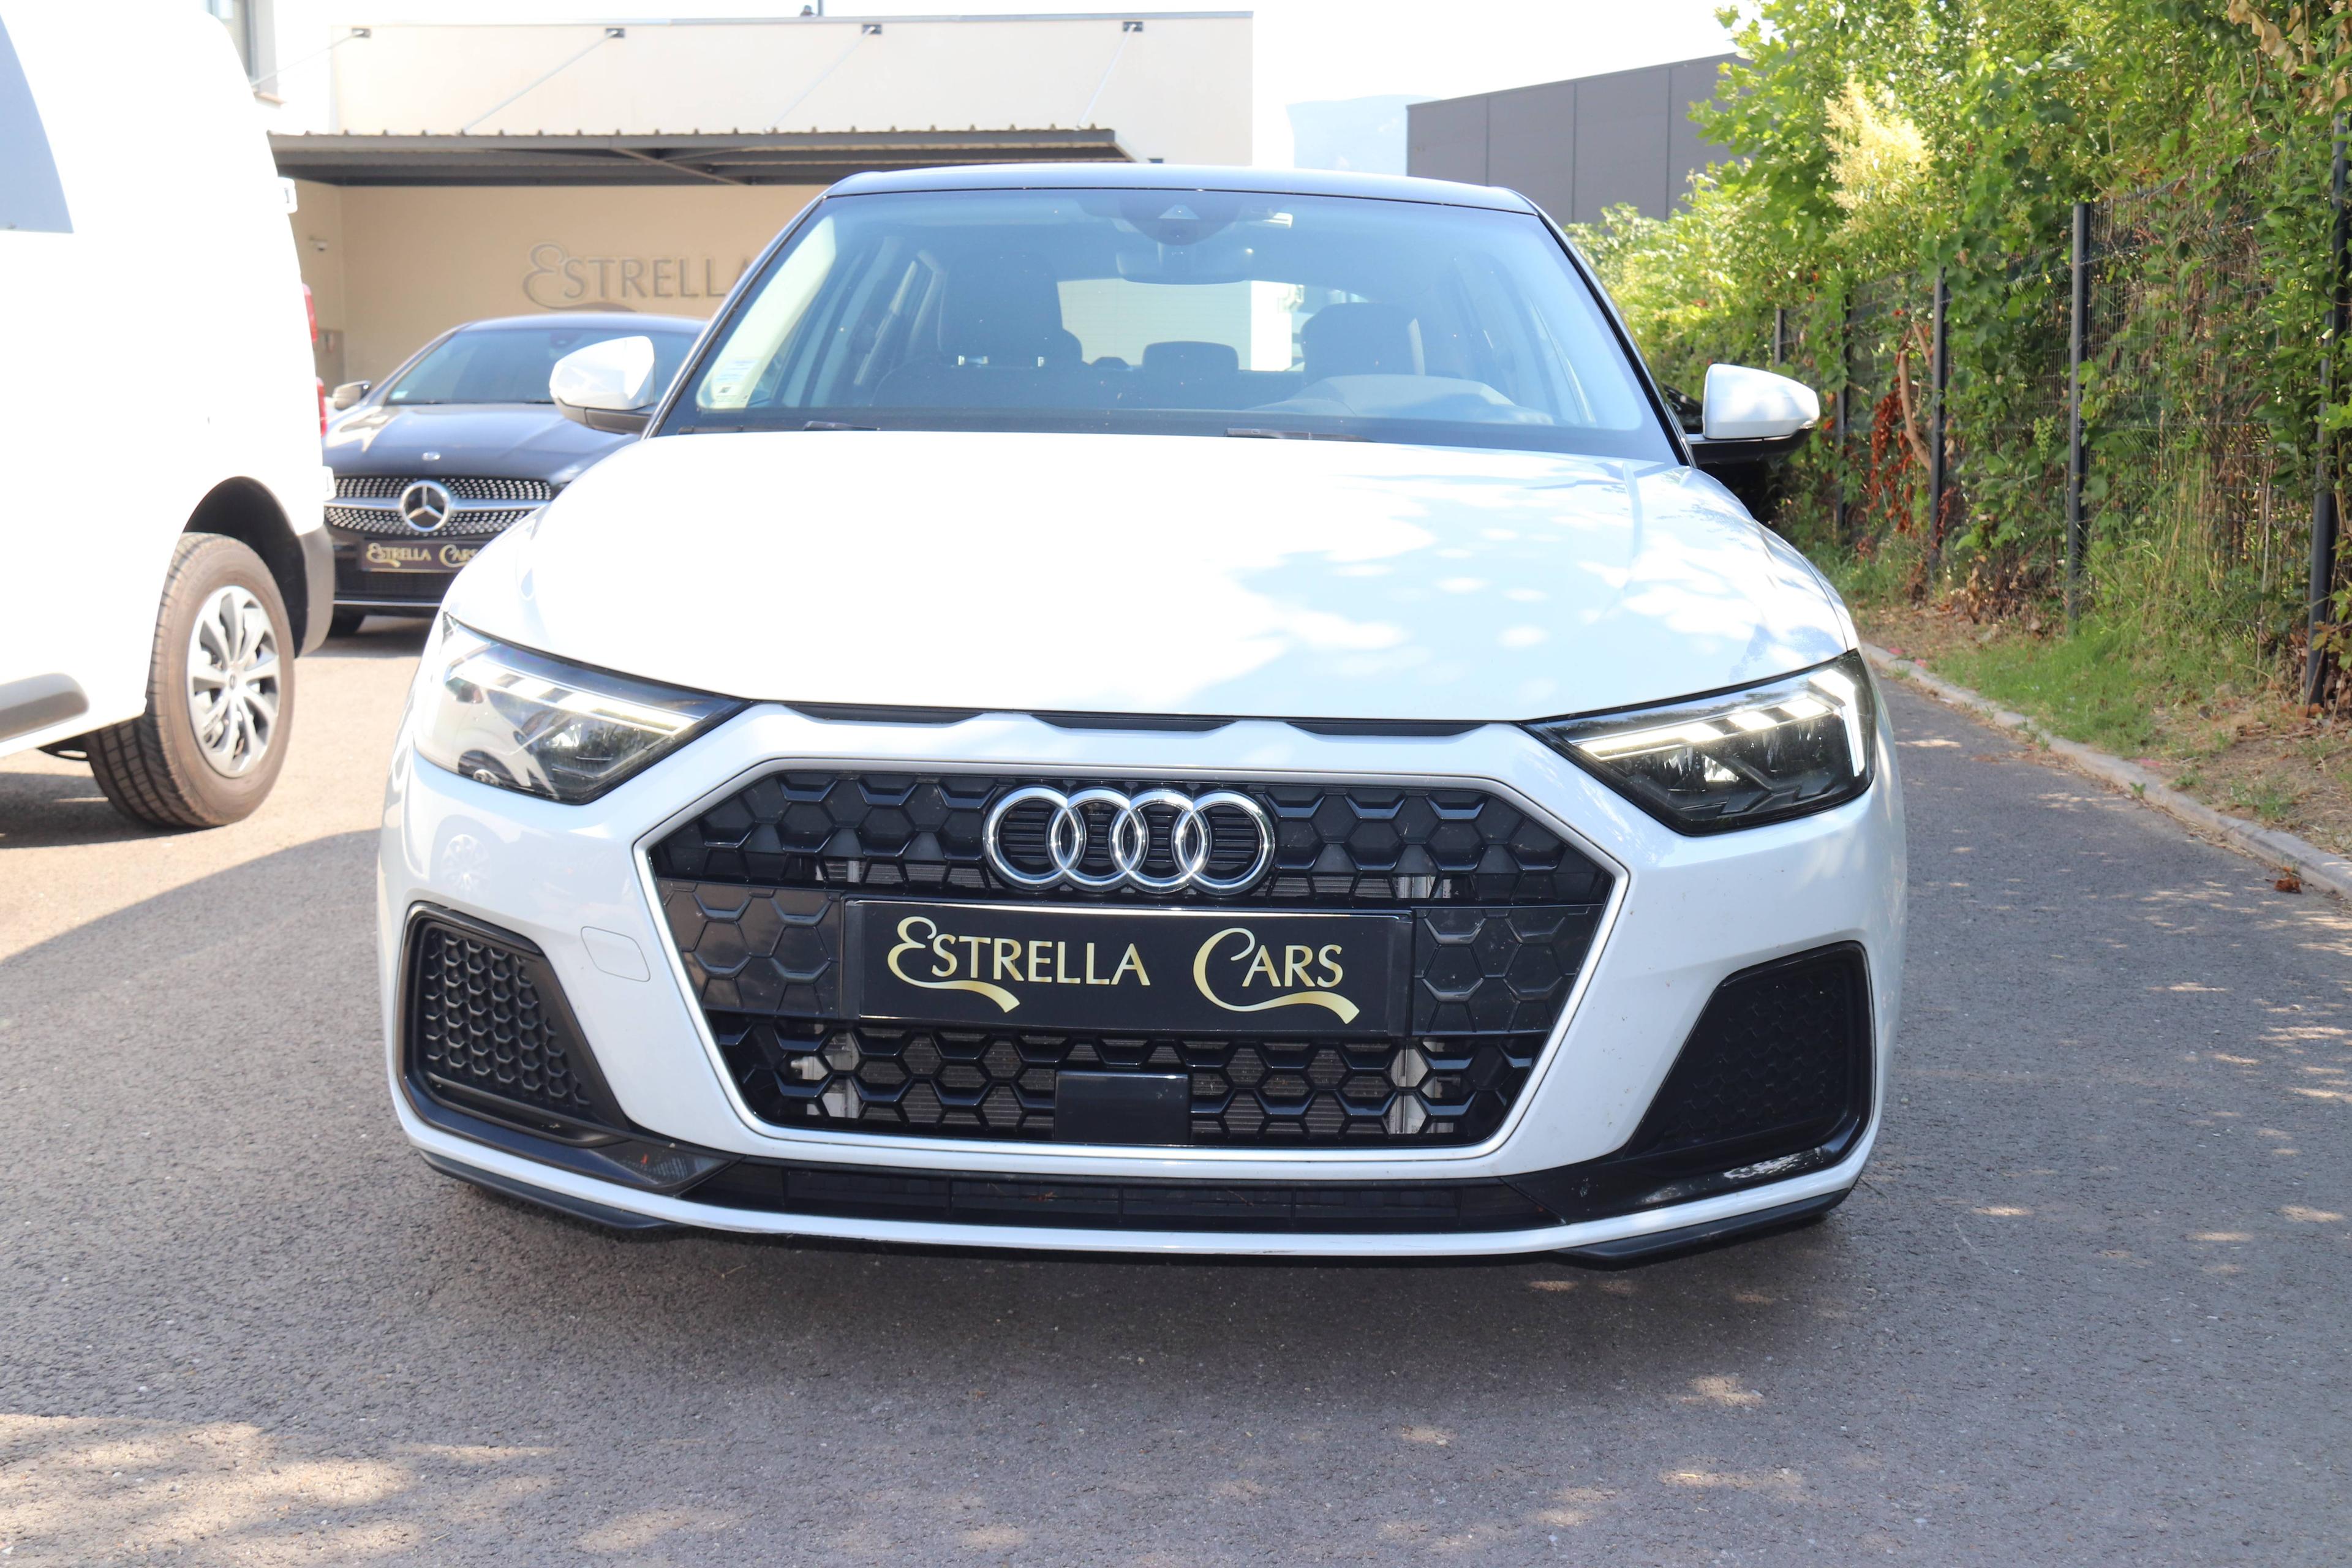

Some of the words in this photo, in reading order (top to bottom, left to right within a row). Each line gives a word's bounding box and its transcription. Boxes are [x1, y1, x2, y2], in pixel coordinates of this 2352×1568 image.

[366, 543, 432, 568] ESTRELLA
[887, 916, 1152, 1014] ESTRELLA
[1193, 927, 1360, 1025] CARS
